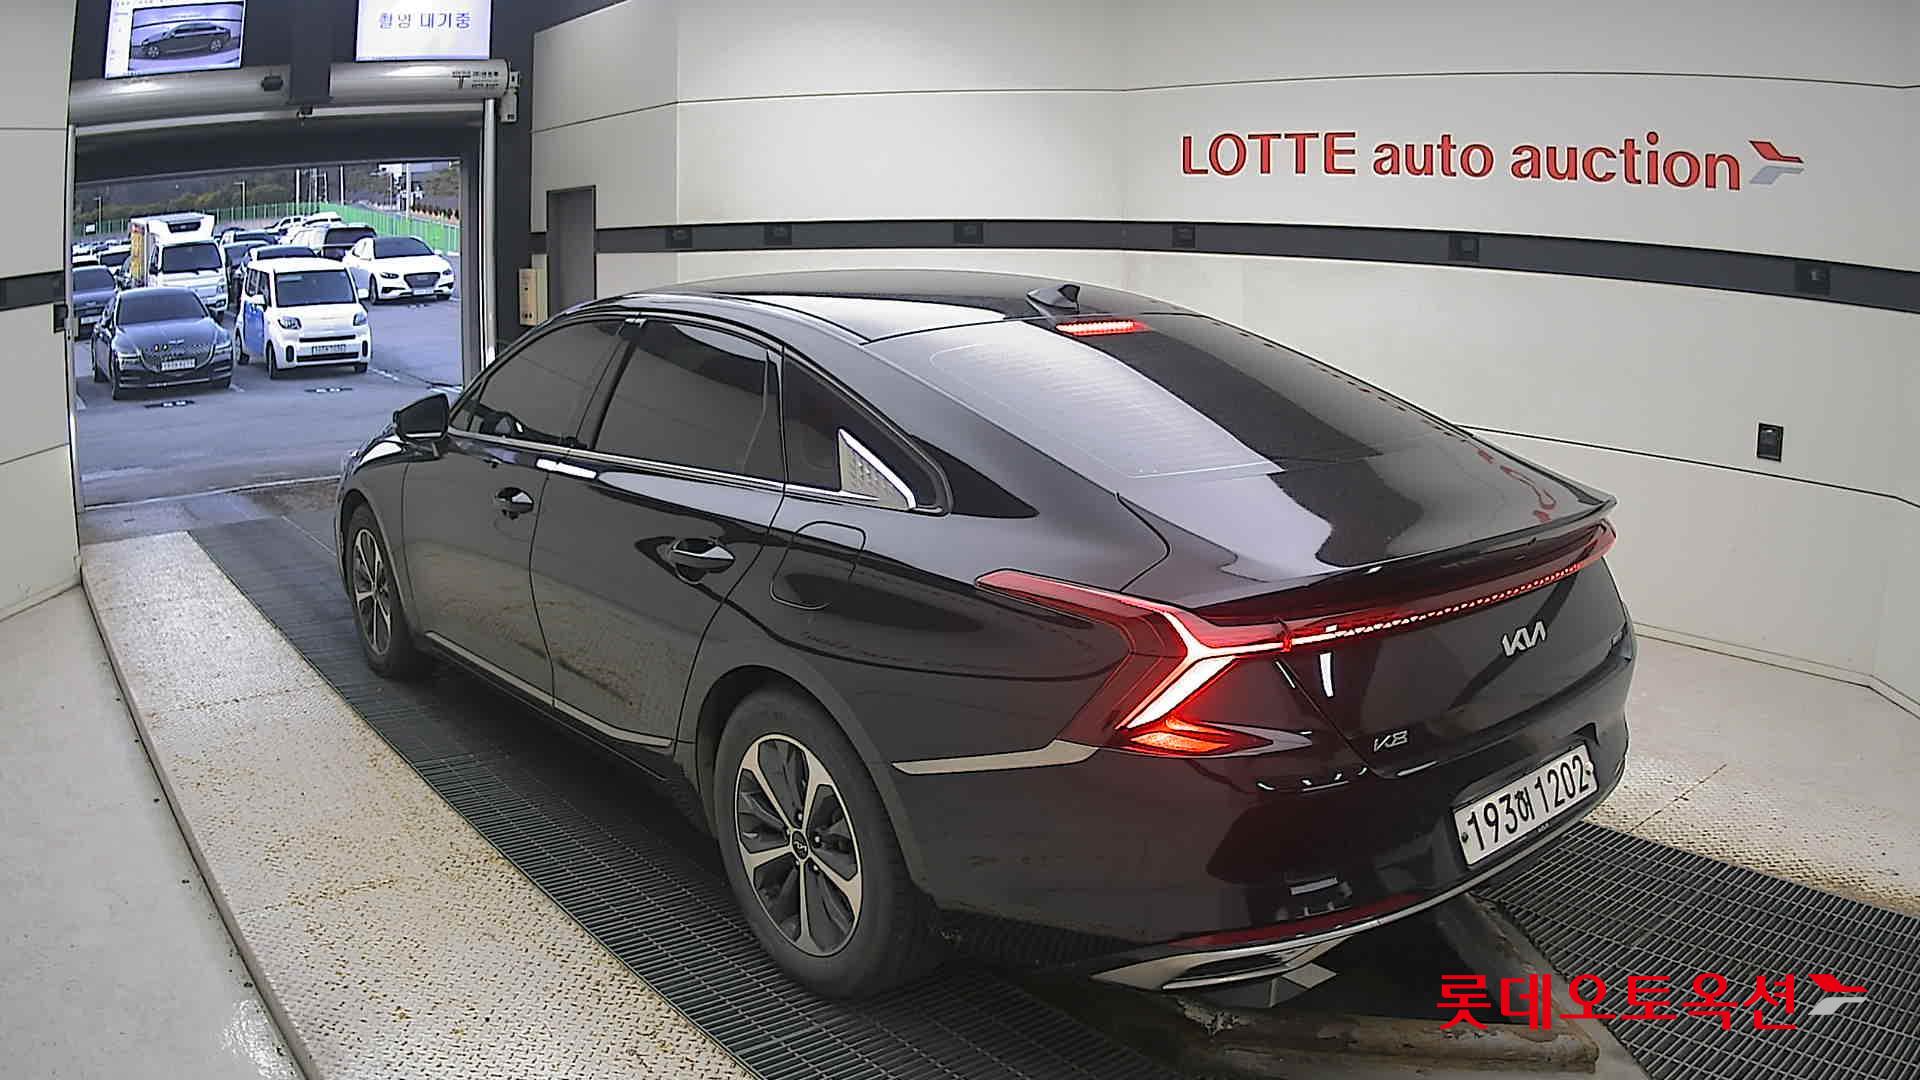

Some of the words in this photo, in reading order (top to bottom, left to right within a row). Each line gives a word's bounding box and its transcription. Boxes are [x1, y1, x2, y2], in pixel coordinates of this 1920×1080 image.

[420, 12, 471, 30] 대기중
[1182, 131, 1356, 176] LOTTE
[1373, 133, 1495, 178] auto
[1510, 131, 1741, 191] auction
[1502, 621, 1547, 657] KIA
[1373, 729, 1408, 752] K8
